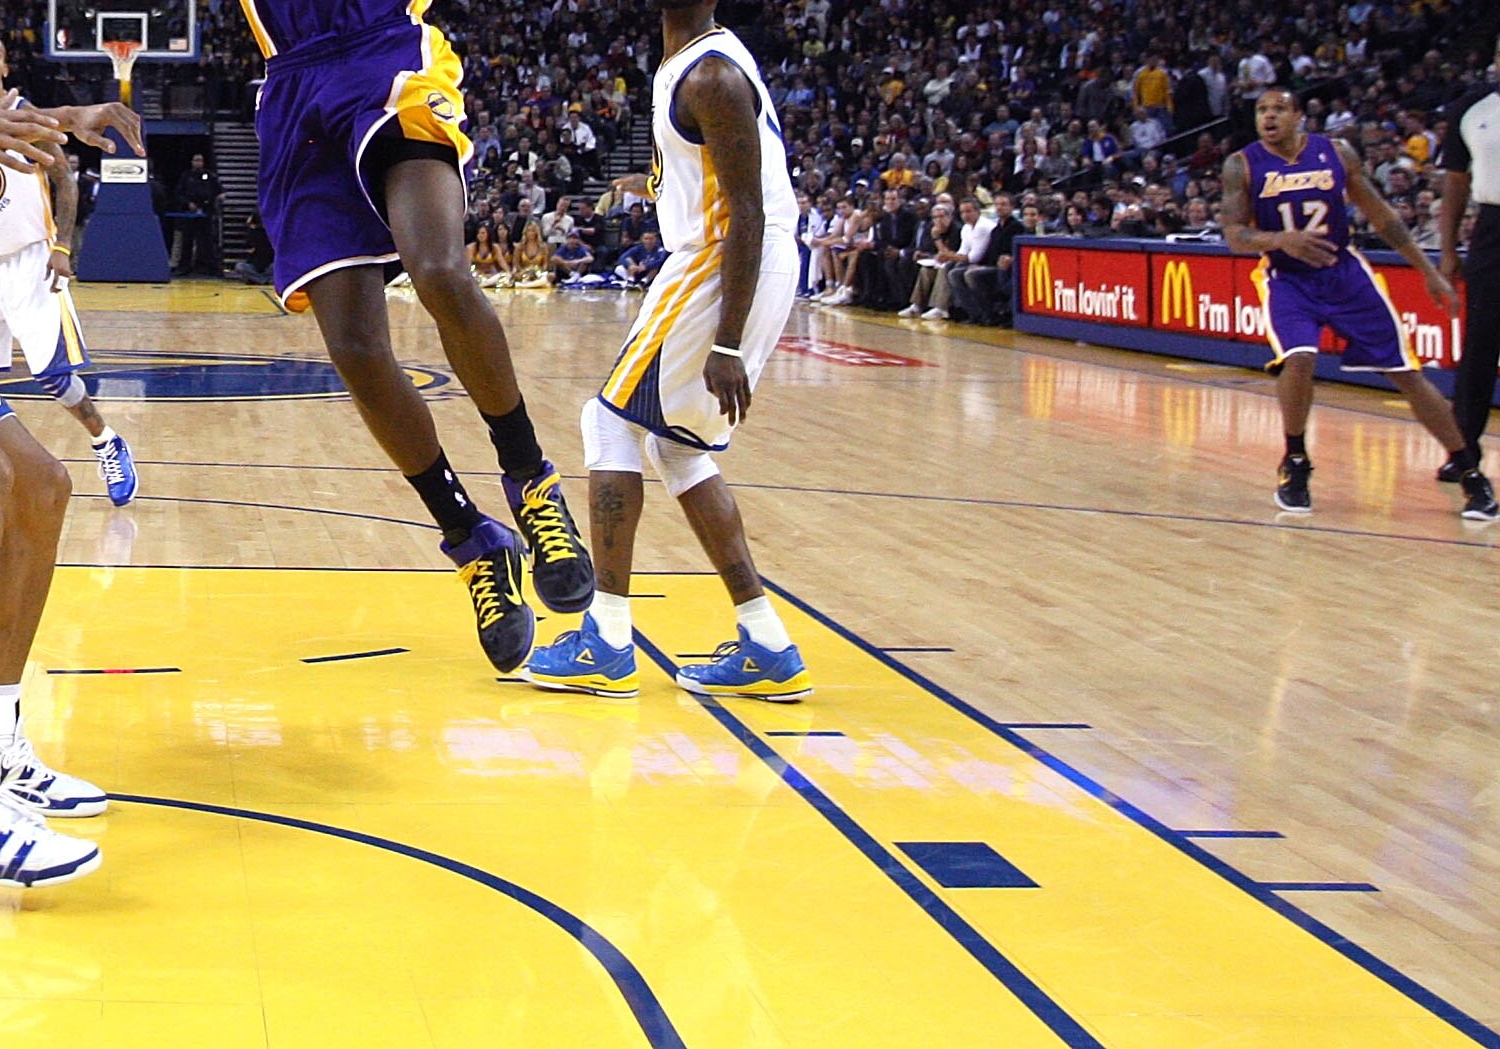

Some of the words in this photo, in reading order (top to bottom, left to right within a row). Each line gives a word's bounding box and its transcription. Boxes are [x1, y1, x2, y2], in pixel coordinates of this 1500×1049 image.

[1259, 169, 1335, 198] LAKERS
[1277, 201, 1329, 234] 12
[1078, 282, 1121, 319] lovin'
[1199, 294, 1230, 333] i'm
